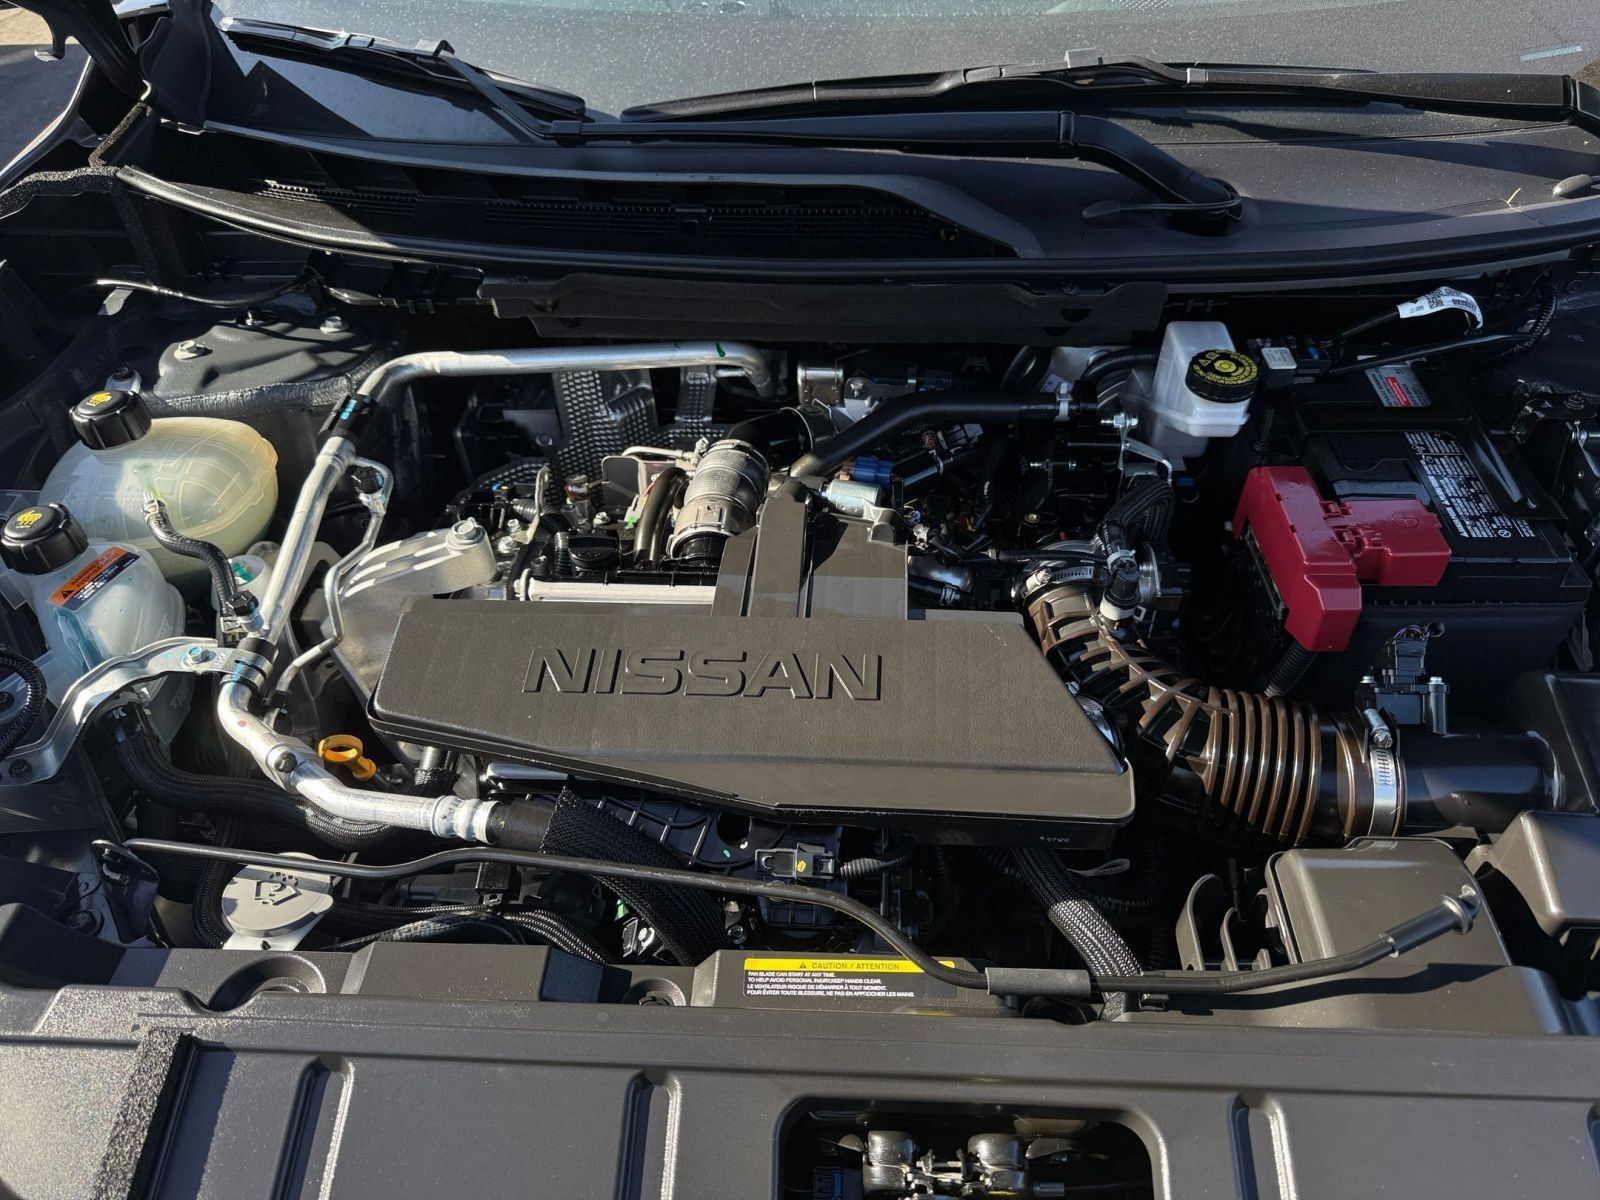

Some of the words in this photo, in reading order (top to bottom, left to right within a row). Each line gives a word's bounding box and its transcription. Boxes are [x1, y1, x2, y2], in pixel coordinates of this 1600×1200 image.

[521, 648, 882, 700] NISSAN
[811, 962, 847, 970] CAUTION
[856, 962, 900, 970] ATTENTION
